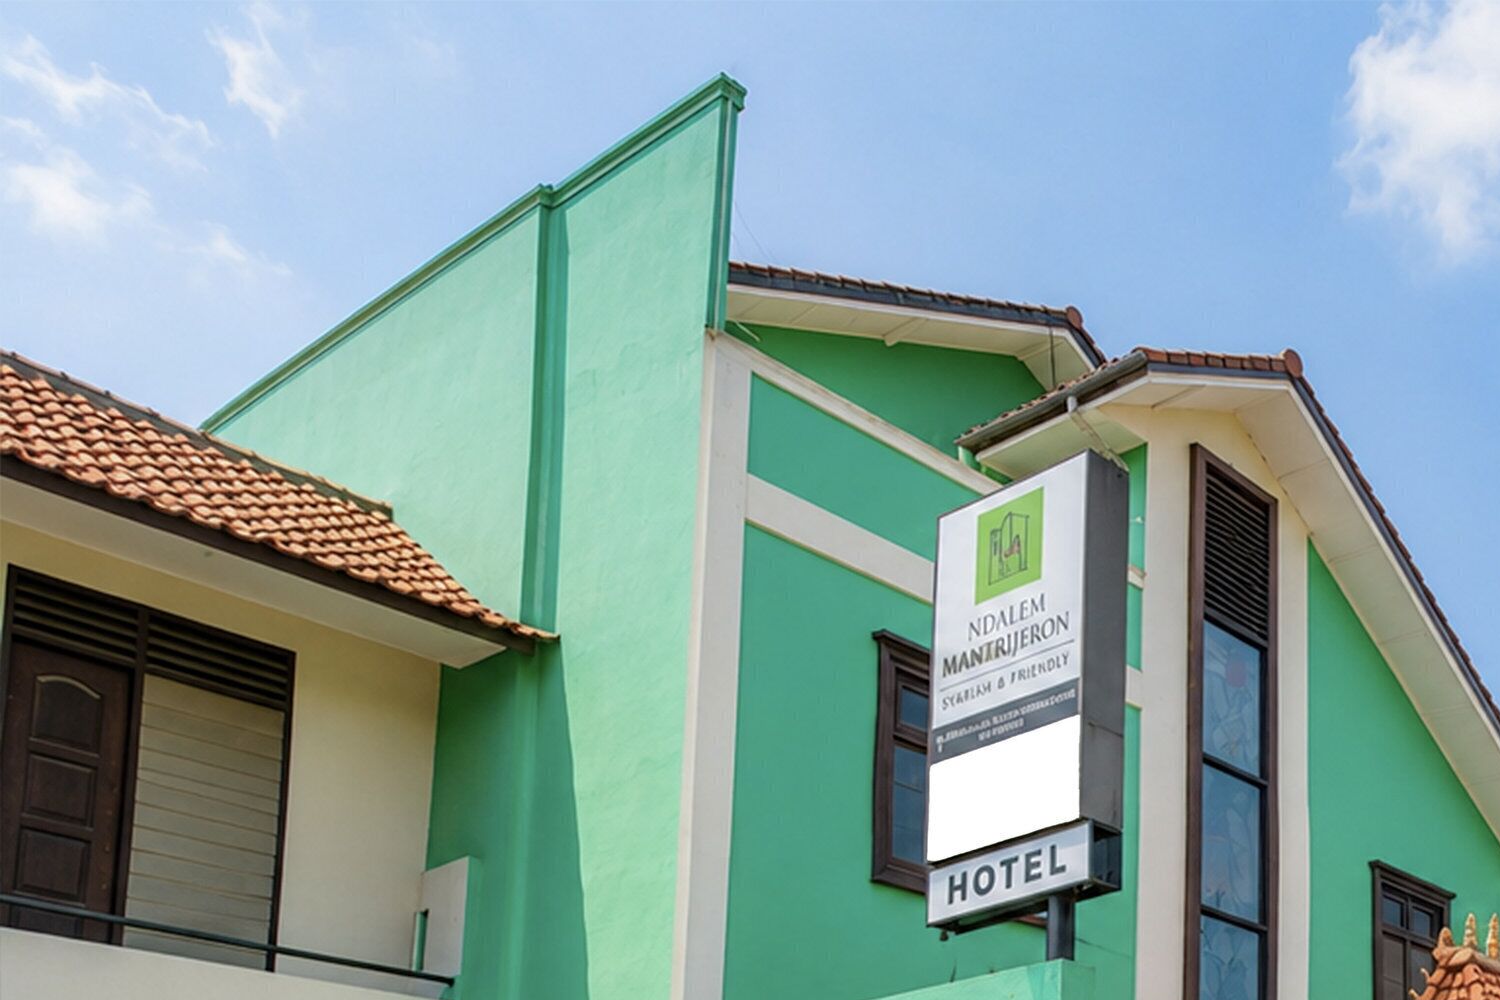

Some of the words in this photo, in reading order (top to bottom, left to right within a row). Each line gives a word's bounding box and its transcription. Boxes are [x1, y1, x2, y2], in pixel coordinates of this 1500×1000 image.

[942, 611, 1070, 677] MANTRIJERON
[968, 593, 1046, 641] NDALEM
[1011, 651, 1070, 684] FRIENDLY
[948, 844, 1067, 905] HOTEL
